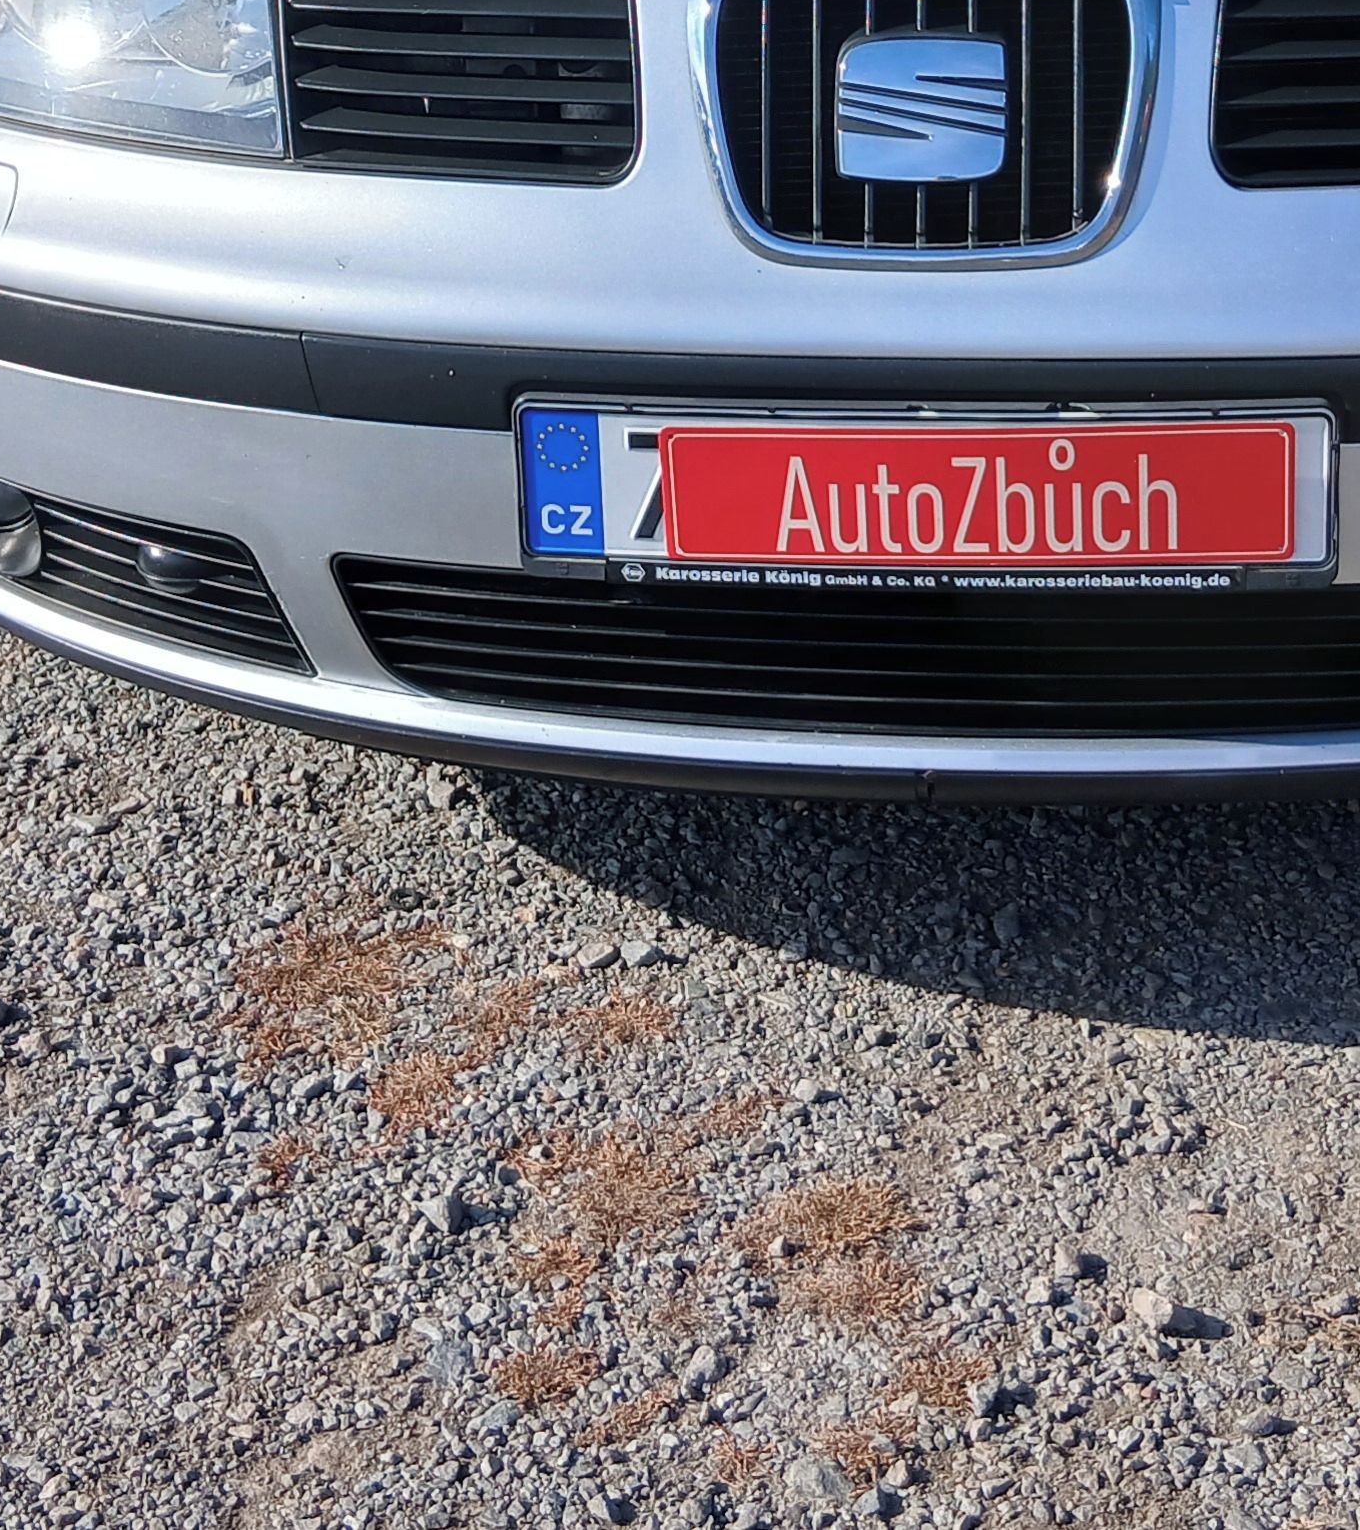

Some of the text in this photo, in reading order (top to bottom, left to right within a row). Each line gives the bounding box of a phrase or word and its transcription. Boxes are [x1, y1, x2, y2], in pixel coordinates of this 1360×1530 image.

[775, 438, 1179, 554] AutoZbůch
[540, 503, 594, 536] CZ
[655, 567, 760, 583] Karosserie
[765, 571, 821, 586] König
[825, 574, 867, 586] GmbH
[871, 575, 883, 586] &
[887, 575, 910, 587] Co.
[913, 575, 936, 588] KG
[953, 573, 1231, 589] www.karosseriebau-koenig.de
